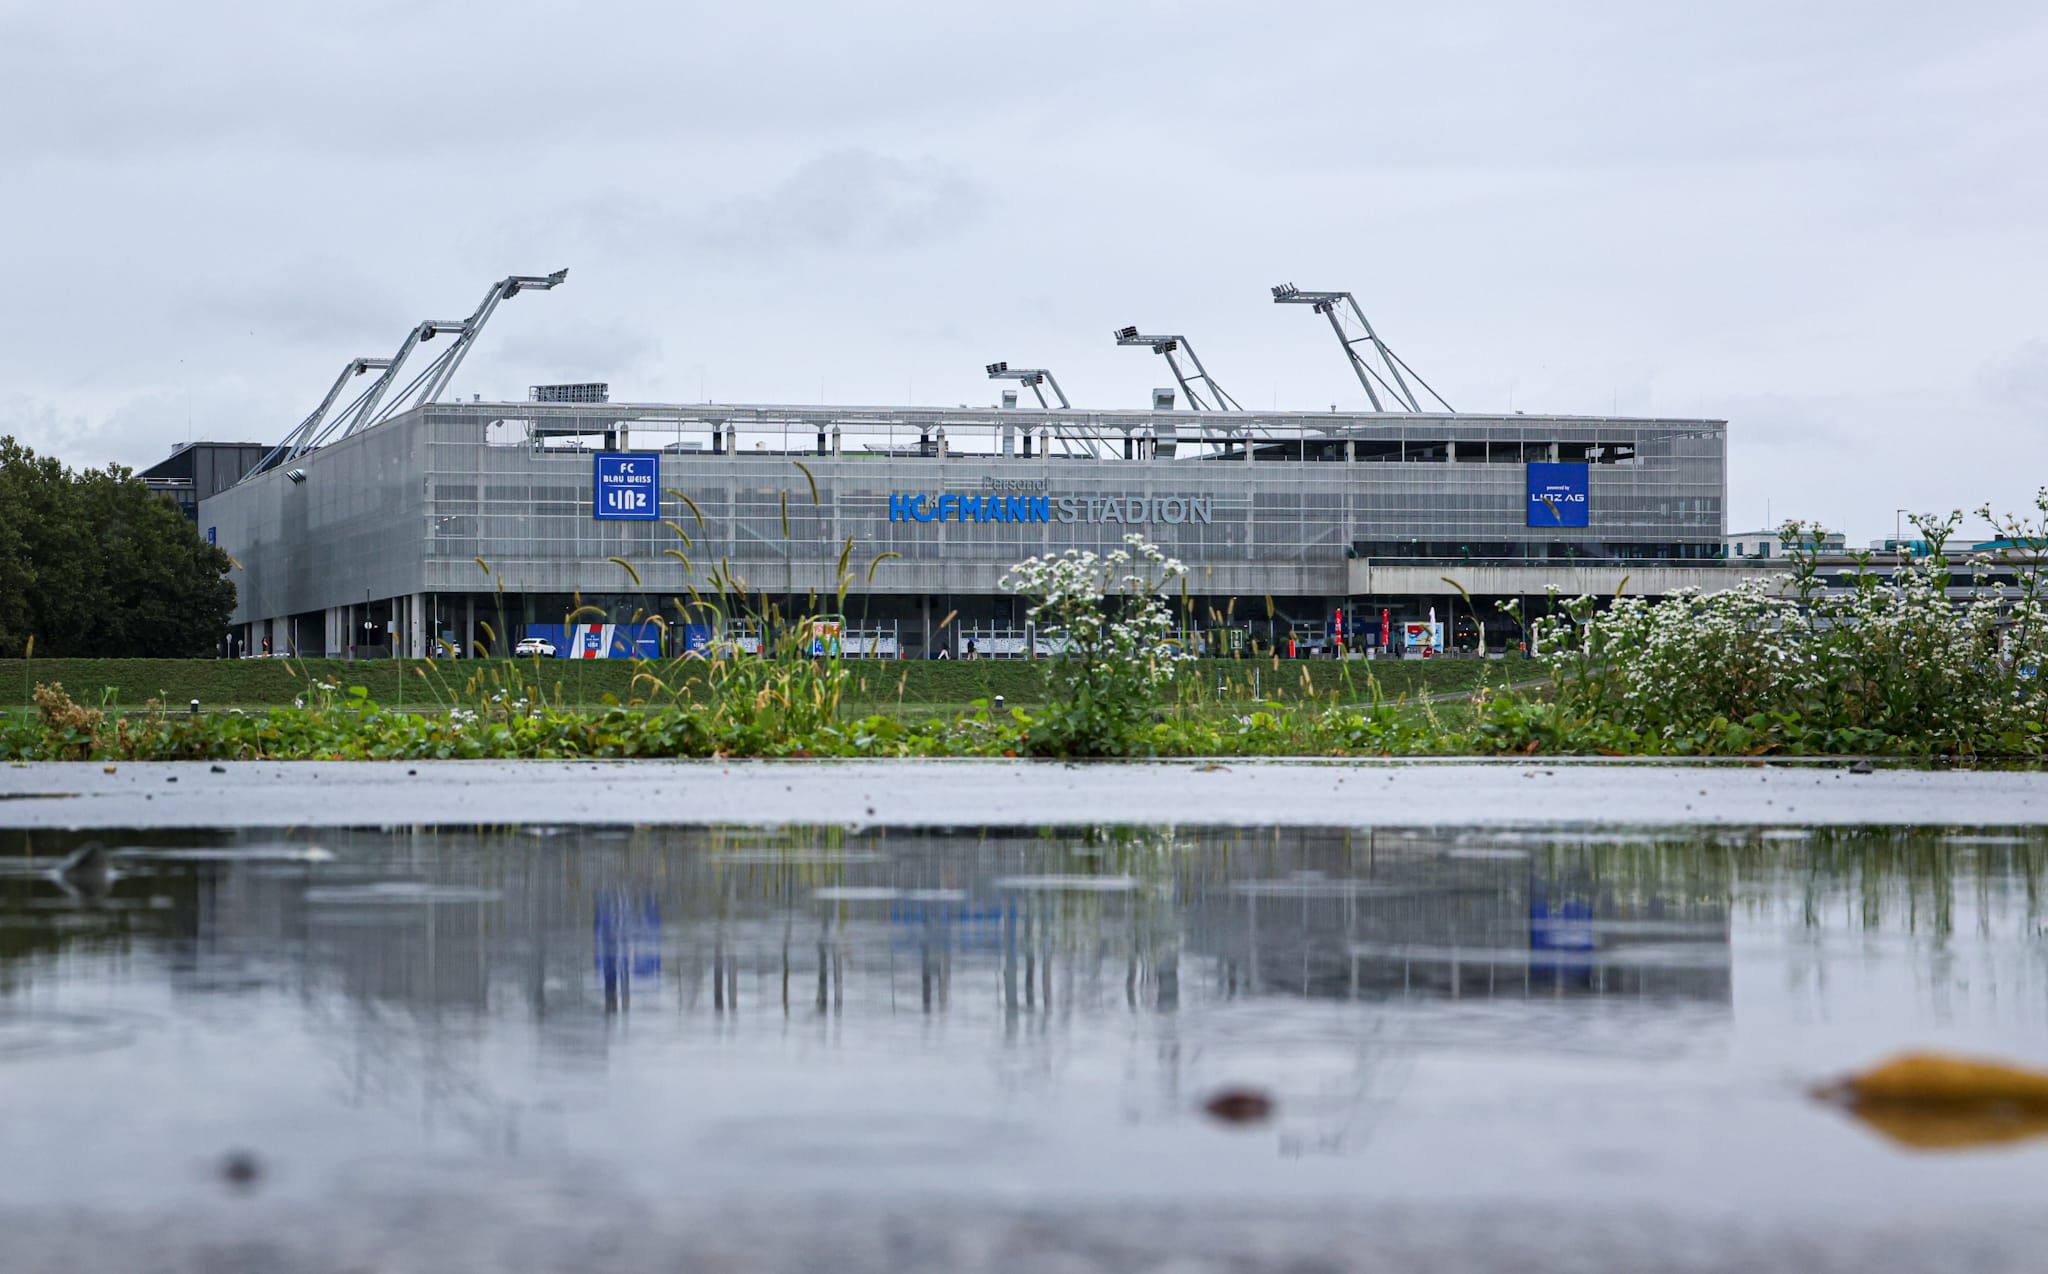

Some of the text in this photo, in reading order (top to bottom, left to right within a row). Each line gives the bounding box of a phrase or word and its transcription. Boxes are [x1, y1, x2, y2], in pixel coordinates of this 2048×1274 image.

[620, 463, 635, 474] FC
[603, 475, 652, 484] BLAU WEISS
[982, 476, 1048, 491] Personal
[1564, 493, 1585, 502] AG
[889, 494, 1214, 525] HOFMANN STADION
